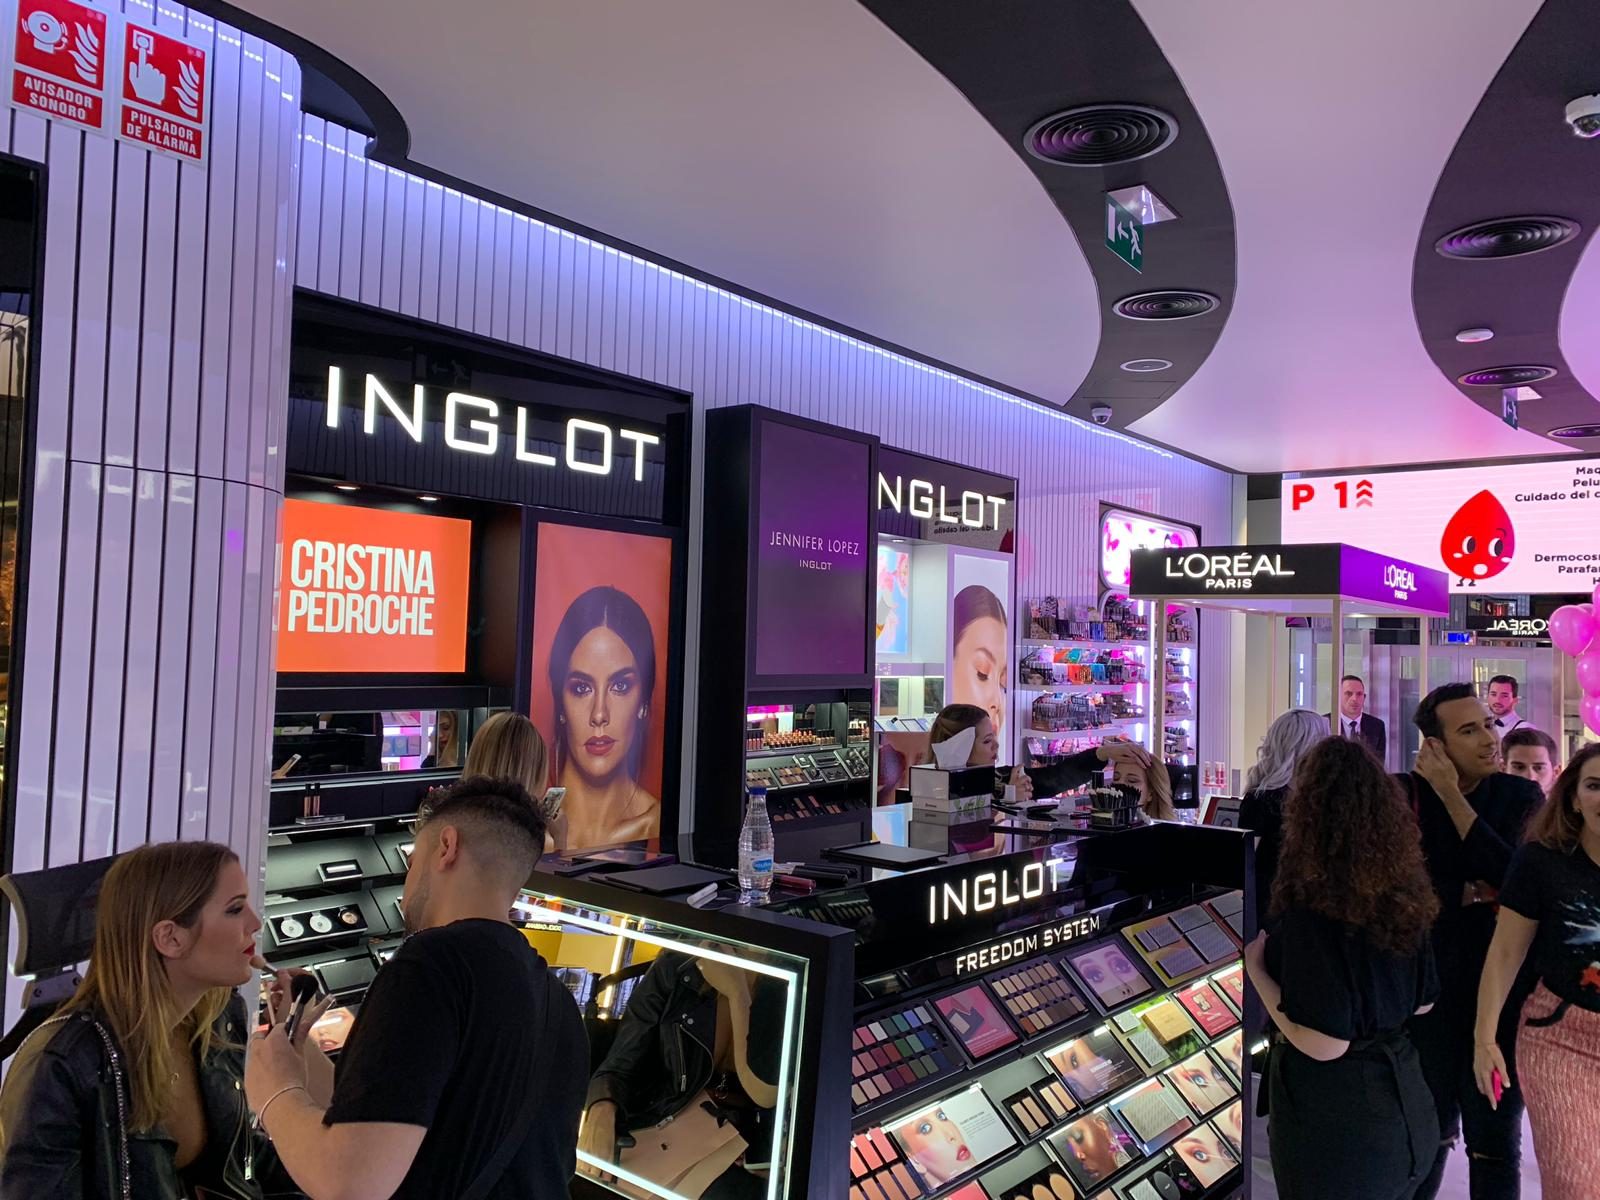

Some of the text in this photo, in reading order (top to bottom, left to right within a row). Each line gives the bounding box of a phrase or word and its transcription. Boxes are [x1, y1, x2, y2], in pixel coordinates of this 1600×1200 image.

[24, 77, 92, 109] AVISADOR
[29, 92, 86, 120] SONORO
[127, 123, 196, 155] DE ALARMA
[131, 111, 193, 140] PULSADOR
[326, 365, 660, 481] INGLOT
[1292, 482, 1348, 510] P 1
[1515, 491, 1566, 502] Cuidado
[1570, 490, 1590, 499] del
[1573, 478, 1600, 487] Pelu
[770, 531, 859, 555] JENNIFER LOPEZ
[290, 538, 435, 595] CRISTINA
[799, 559, 832, 571] INGLOT
[1165, 551, 1295, 578] L'ORÉAL
[1534, 553, 1600, 562] Dermocos
[1205, 578, 1253, 589] PARIS
[1383, 563, 1418, 592] L'ORÉAL
[1394, 589, 1408, 601] PARIS
[287, 589, 435, 636] PEDROCHE
[929, 857, 1064, 924] INGLOT
[956, 915, 1100, 975] FREEDOM SYSTEM
